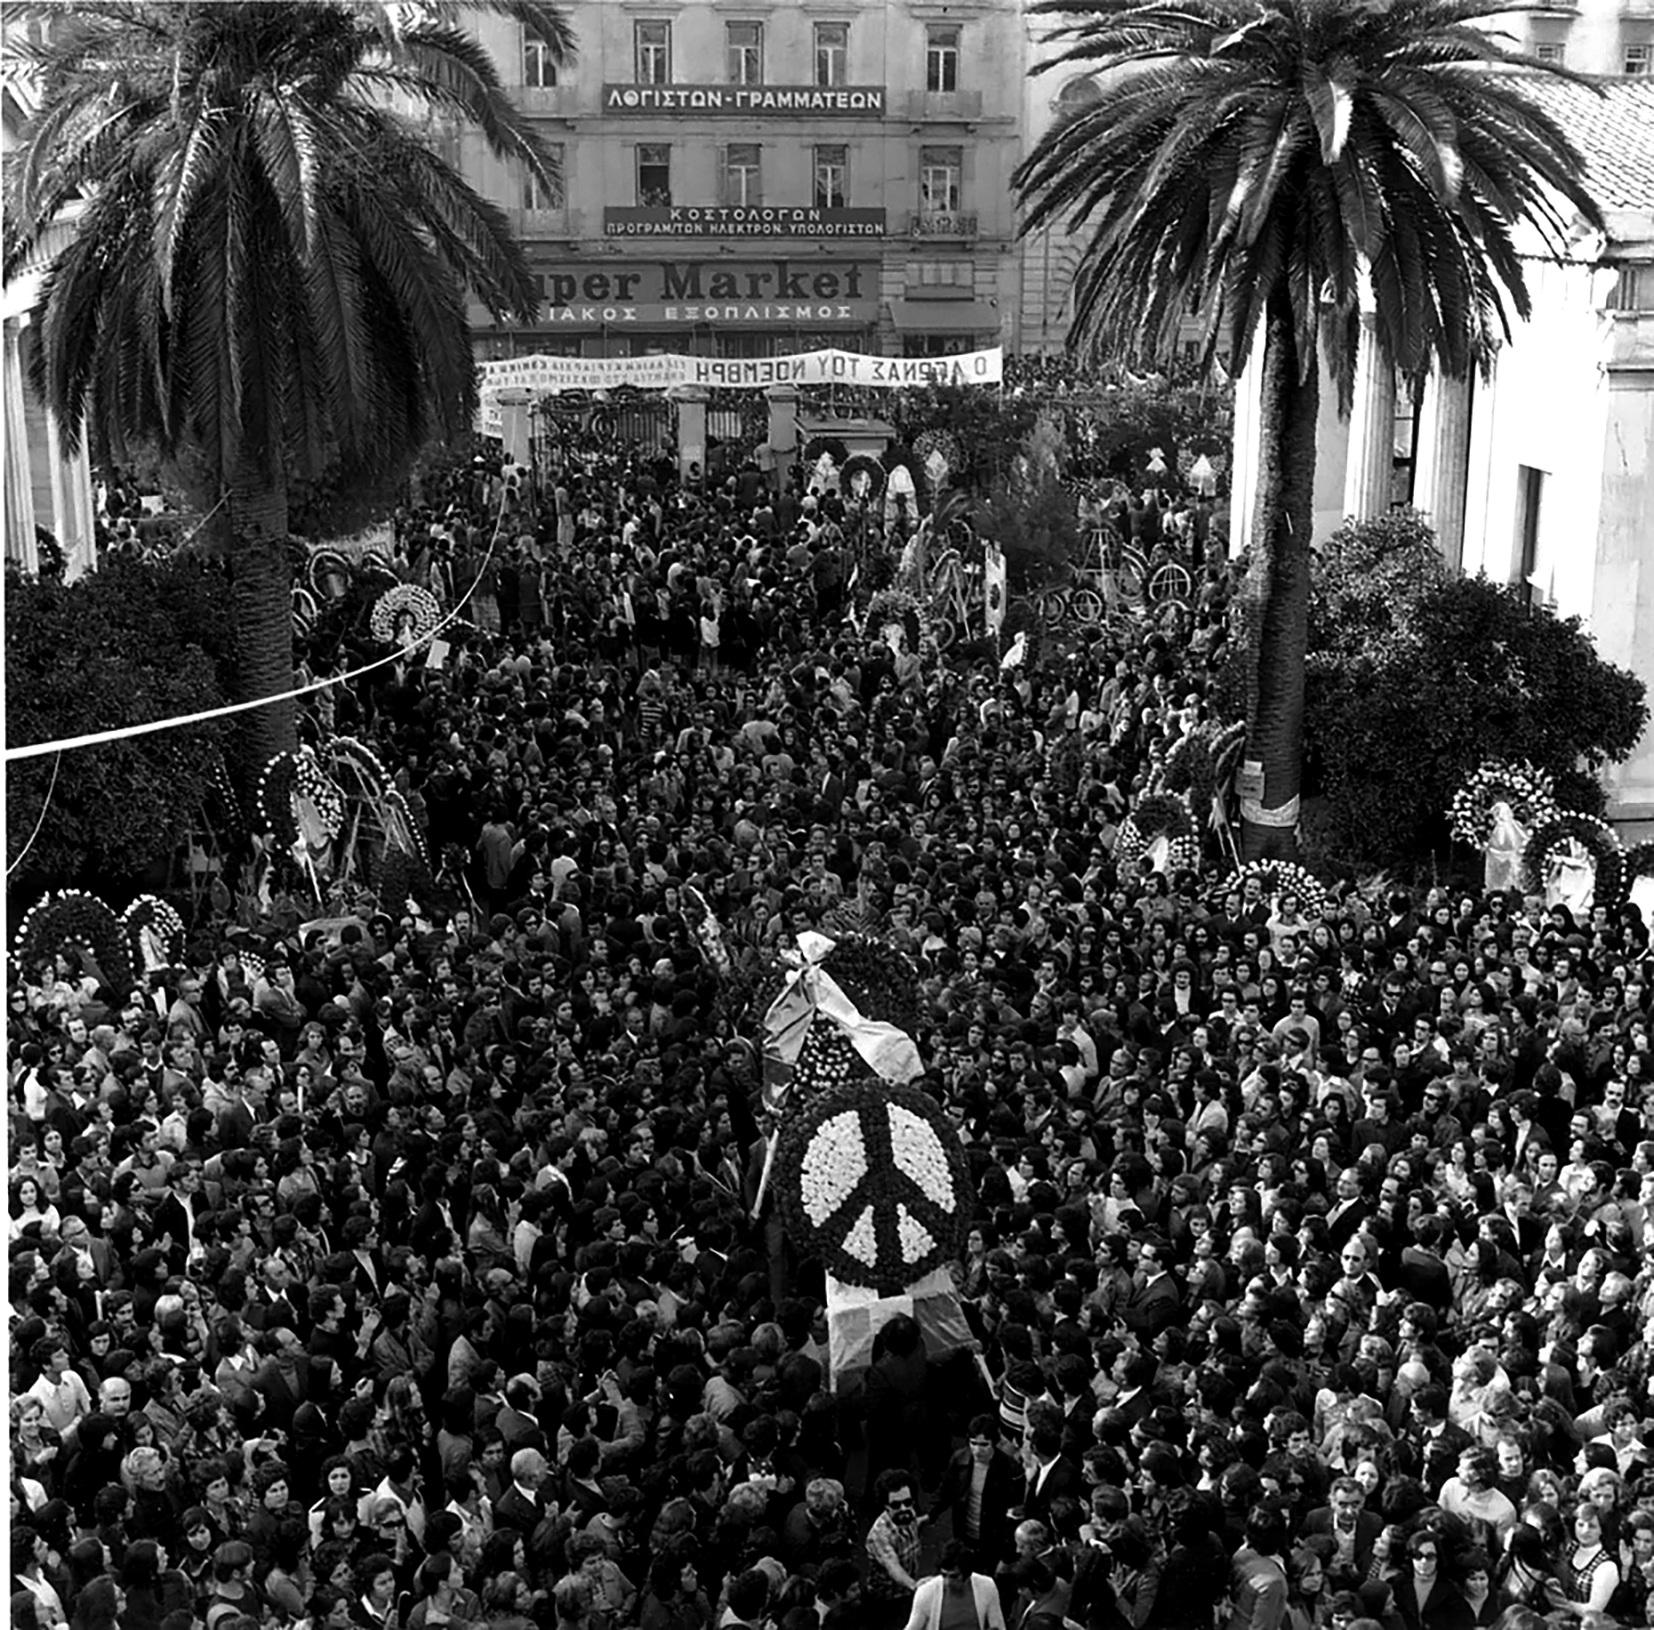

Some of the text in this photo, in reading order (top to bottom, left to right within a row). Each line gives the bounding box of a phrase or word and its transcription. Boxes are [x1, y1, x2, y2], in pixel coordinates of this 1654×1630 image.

[669, 208, 820, 221] ΚΟΣΤΟΛΟΓΩΝ
[788, 223, 884, 235] ΥΠΟΛΟΓΙΣΤΩΝ
[528, 260, 863, 307] uper Market
[664, 305, 851, 321] ΕΞΟΠΛΙΣΜΟΣ
